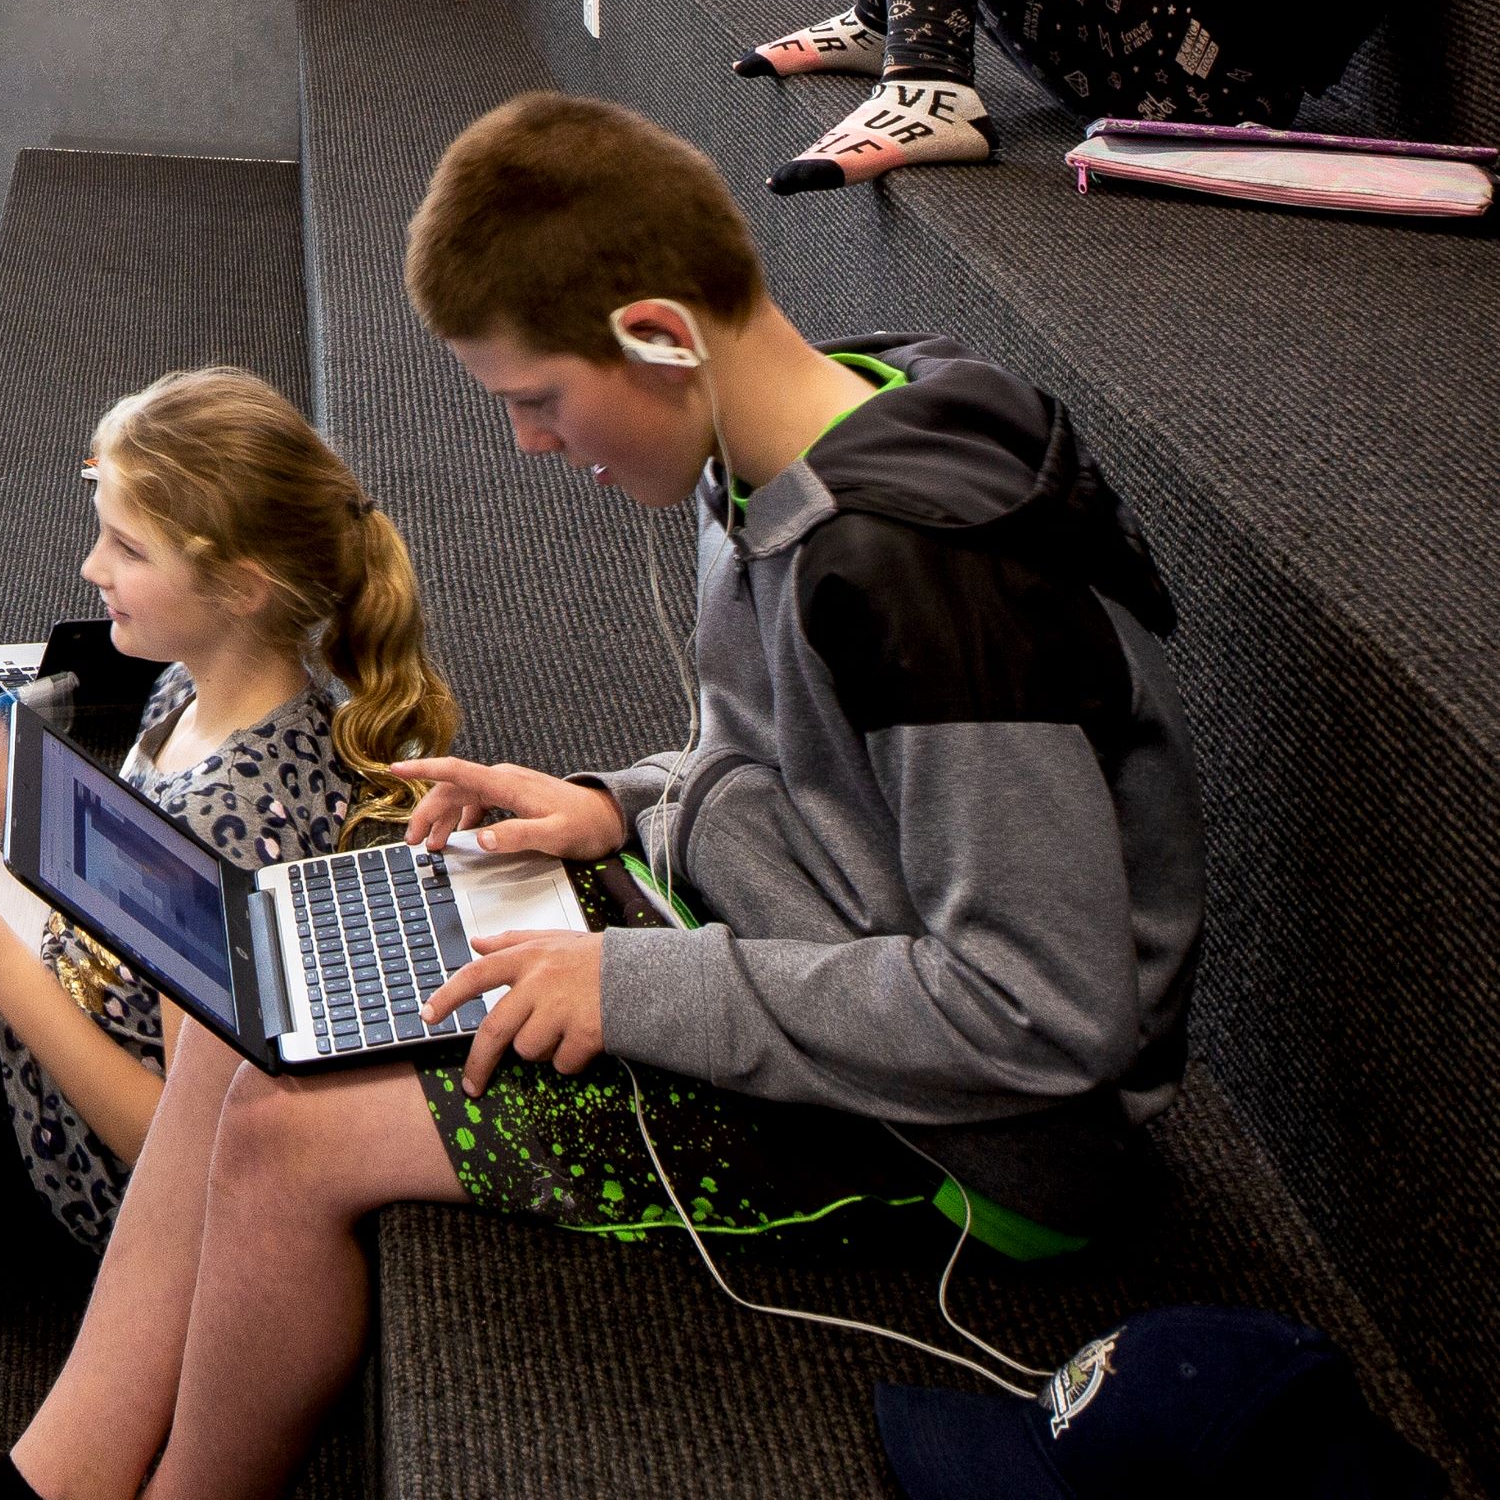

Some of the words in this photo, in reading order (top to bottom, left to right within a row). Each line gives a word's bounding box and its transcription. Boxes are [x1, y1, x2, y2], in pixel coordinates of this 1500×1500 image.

[1120, 19, 1149, 44] forever
[1133, 28, 1153, 49] never
[871, 83, 957, 124] OVE
[864, 110, 935, 145] UR
